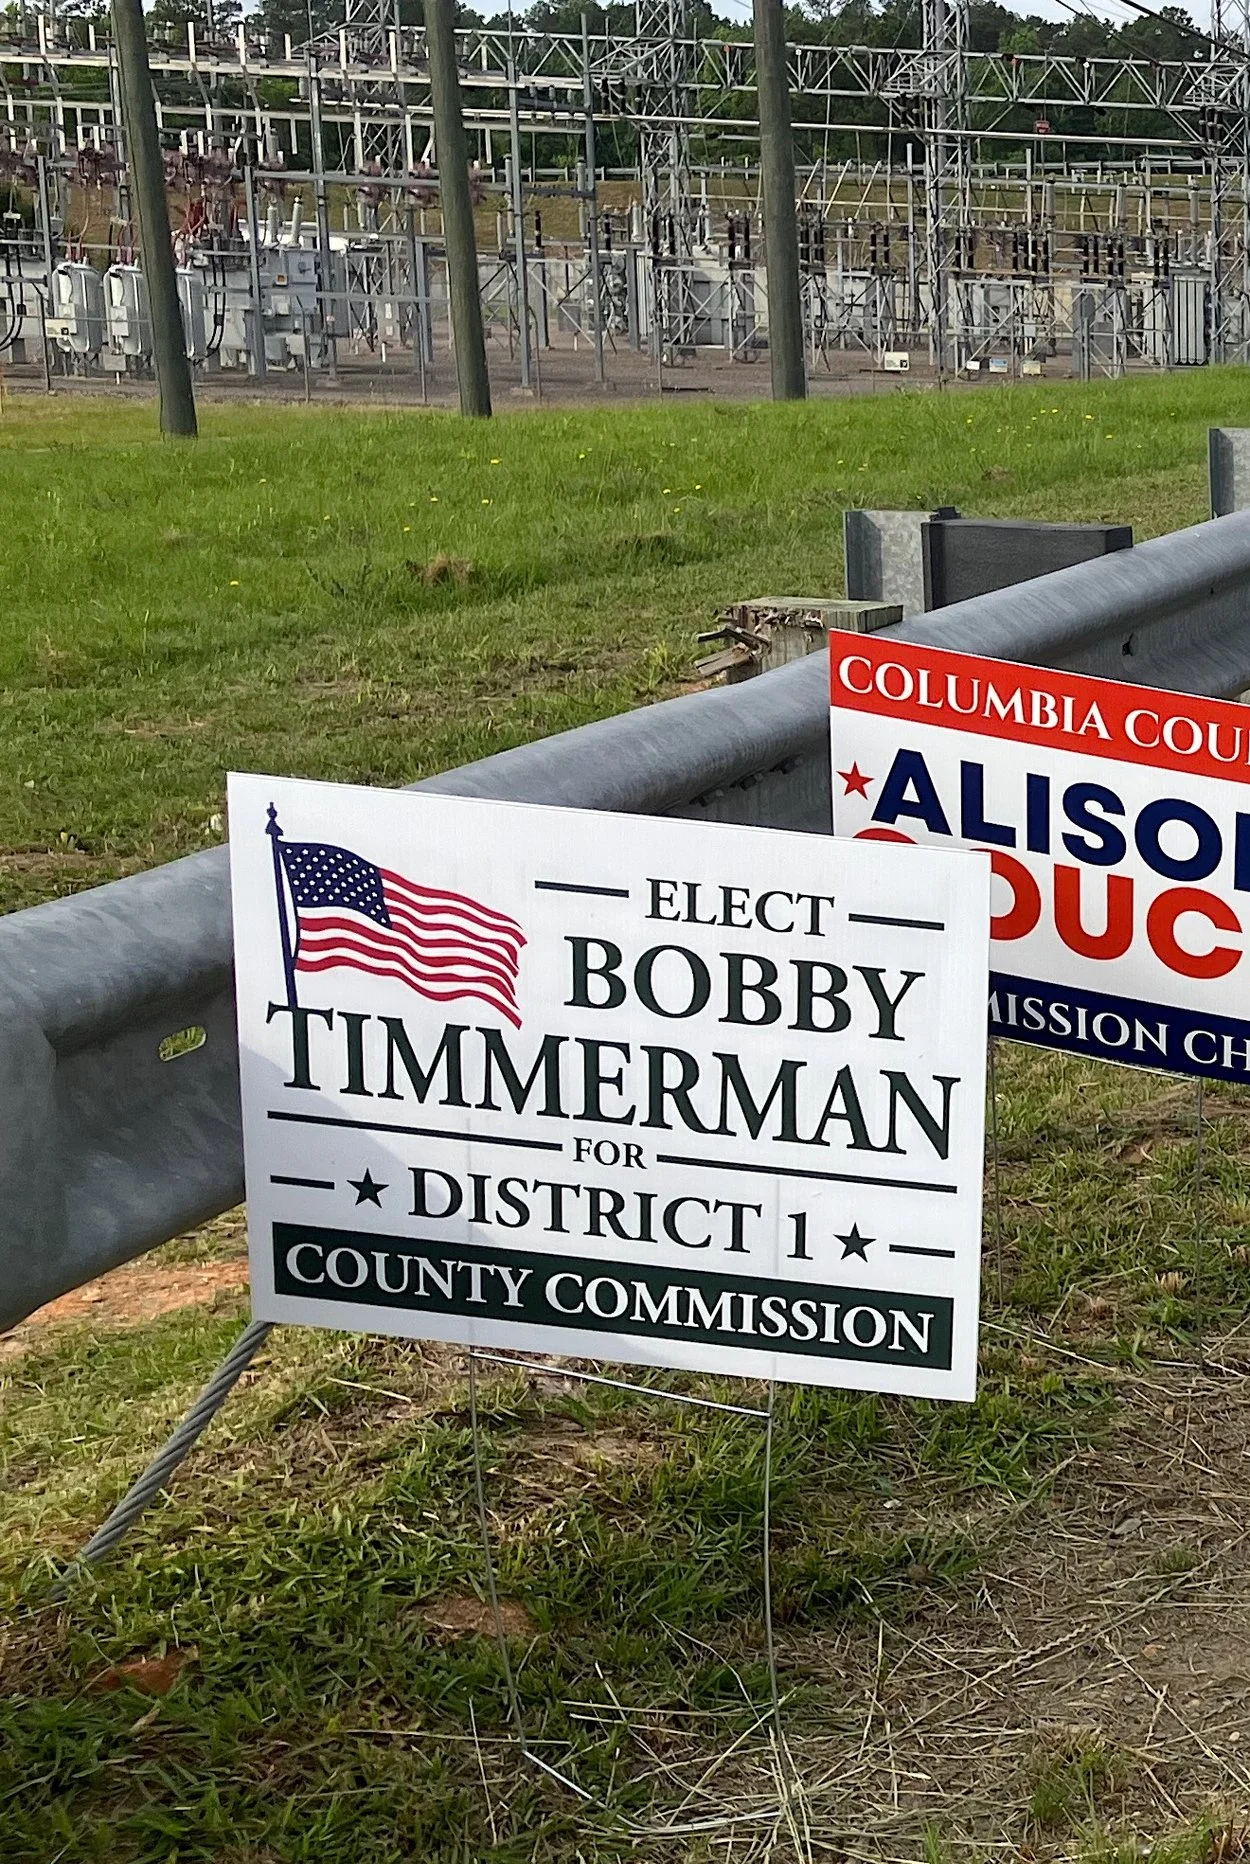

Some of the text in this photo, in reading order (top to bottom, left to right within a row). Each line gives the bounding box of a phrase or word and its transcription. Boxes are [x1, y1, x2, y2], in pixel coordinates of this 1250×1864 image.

[838, 654, 1114, 742] COLUMBIA
[645, 877, 835, 937] ELECT
[564, 935, 926, 1042] BOBBY
[266, 1000, 962, 1161] TIMMERMAN
[572, 1137, 647, 1171] FOR
[408, 1166, 813, 1261] DISTRICT 1
[285, 1243, 935, 1354] COUNTY COMMISSION
